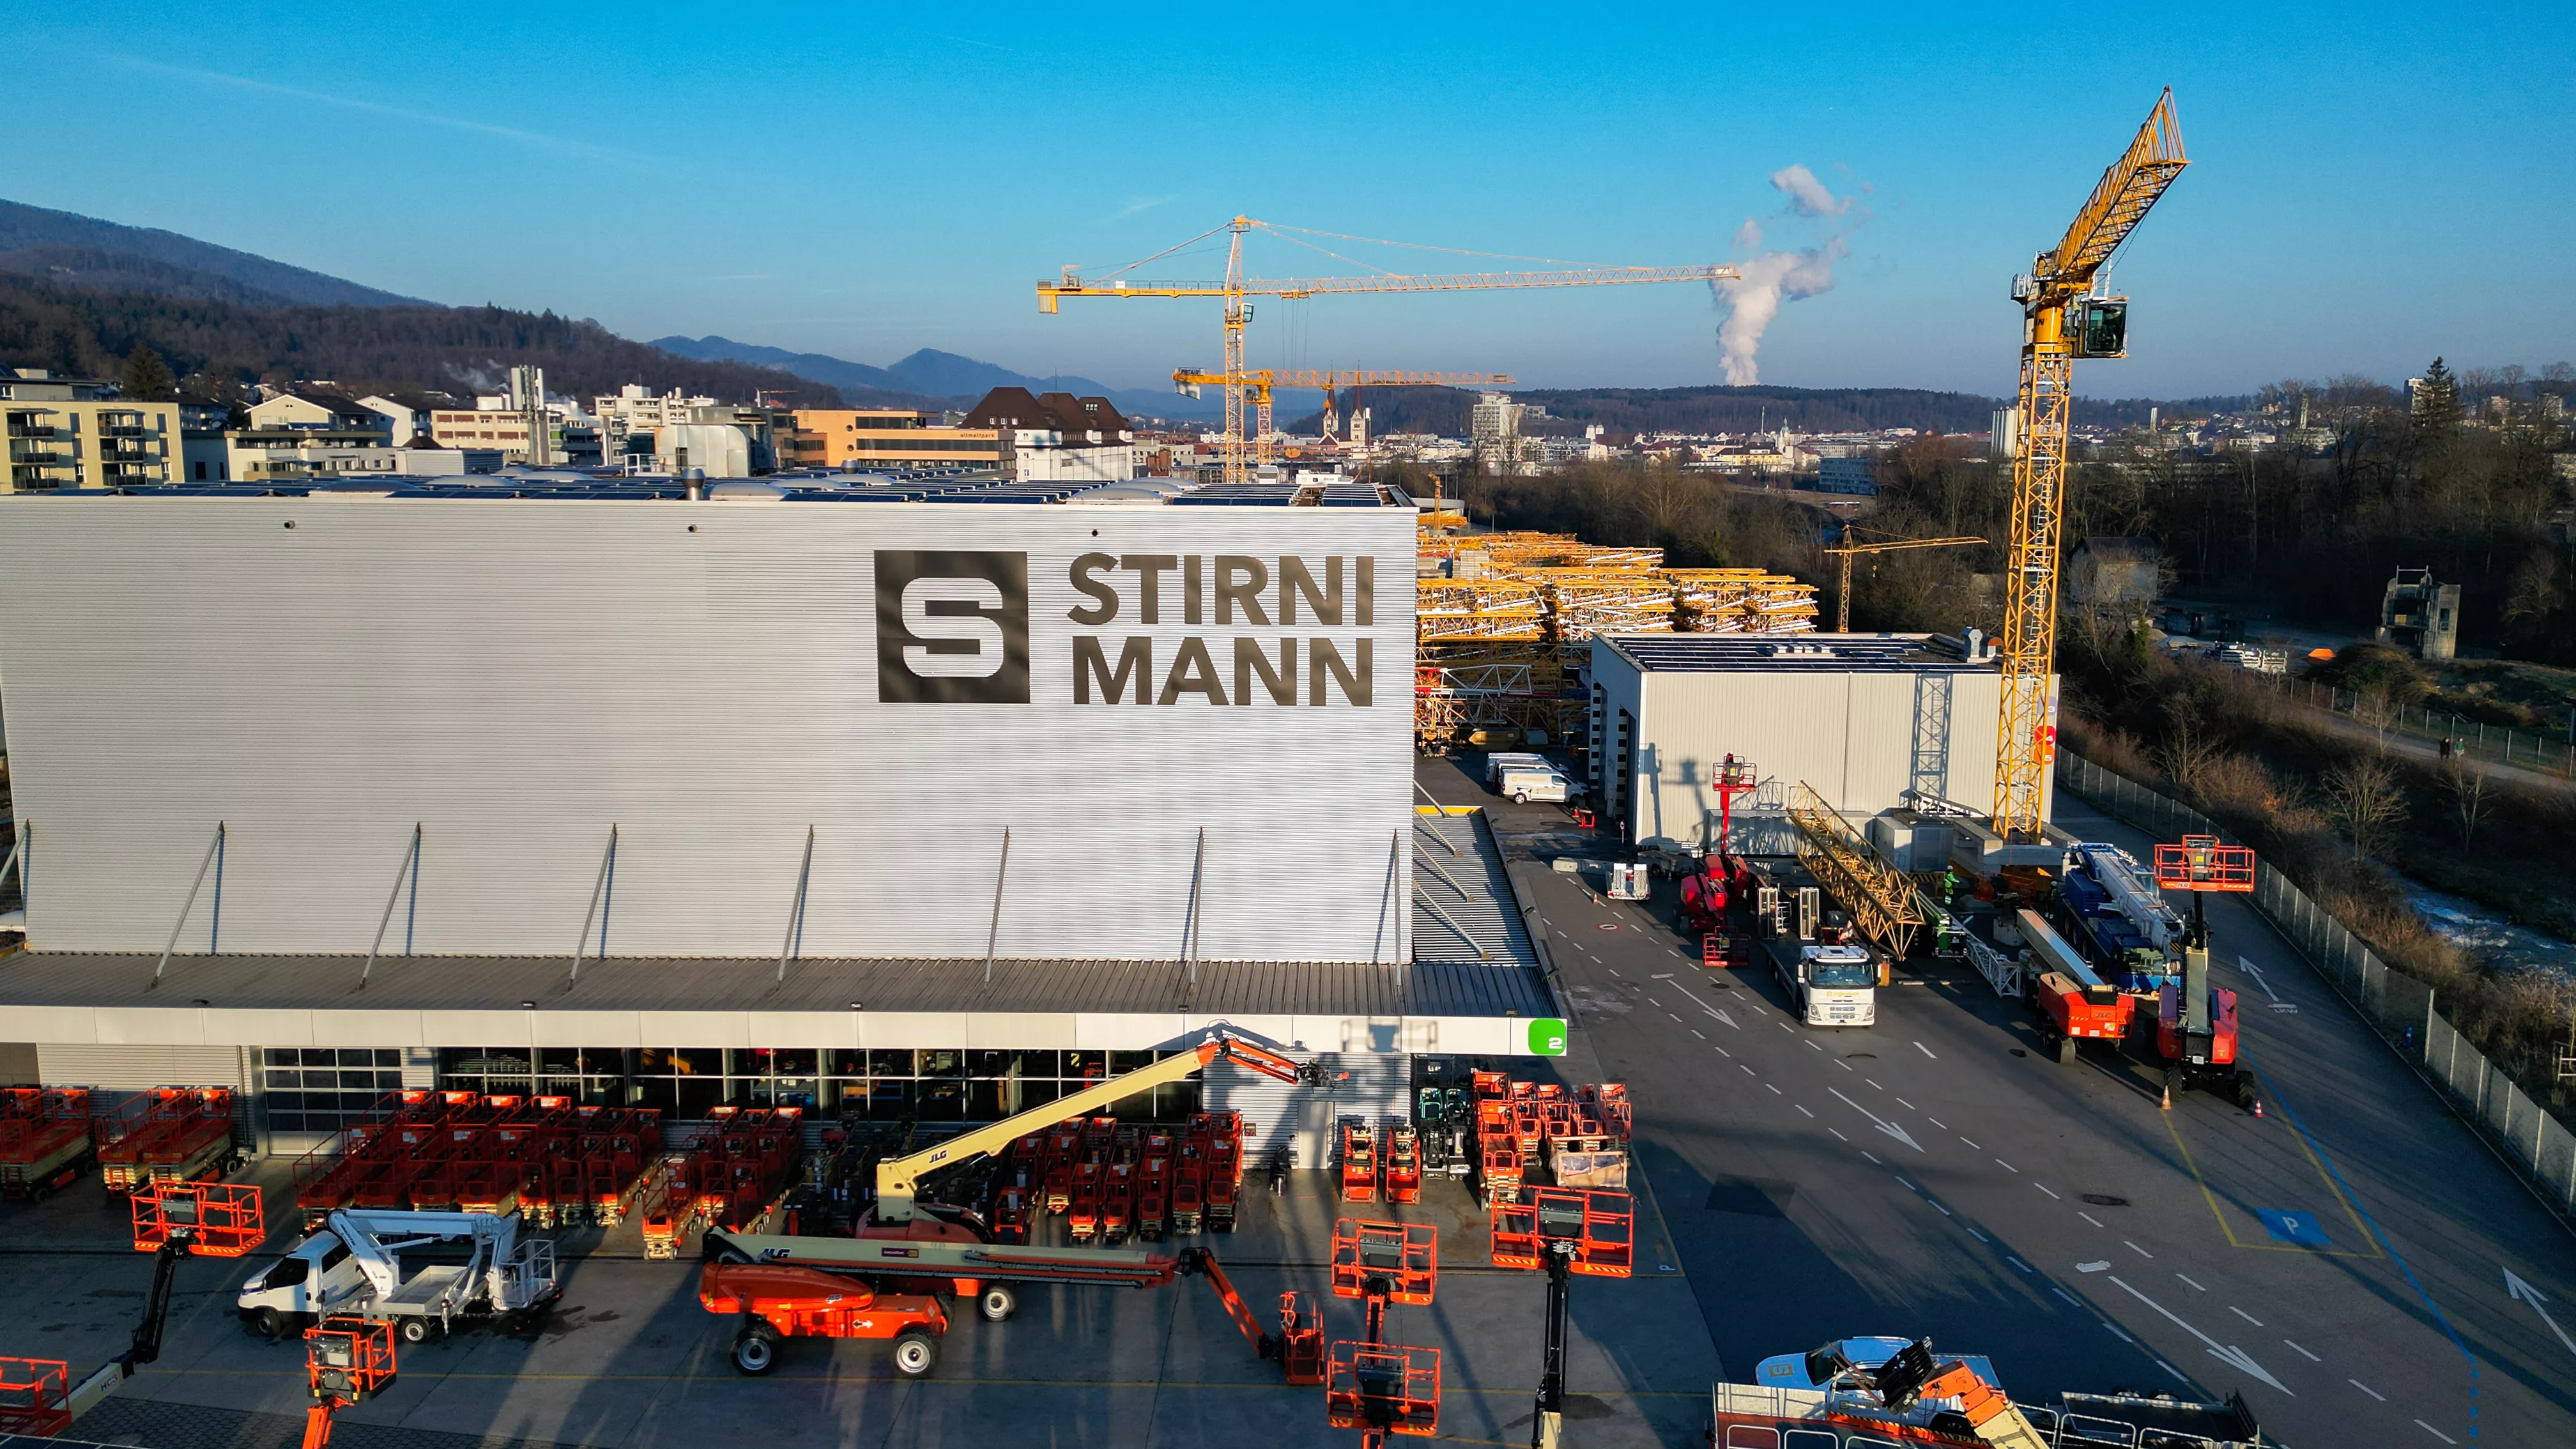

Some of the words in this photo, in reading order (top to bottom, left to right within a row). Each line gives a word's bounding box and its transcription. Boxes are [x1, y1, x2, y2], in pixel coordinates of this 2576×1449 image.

[1067, 551, 1374, 625] STIRNI
[1072, 636, 1374, 707] MANN
[1548, 1037, 1563, 1050] 2
[929, 1150, 947, 1163] JLG
[2282, 1216, 2299, 1235] P
